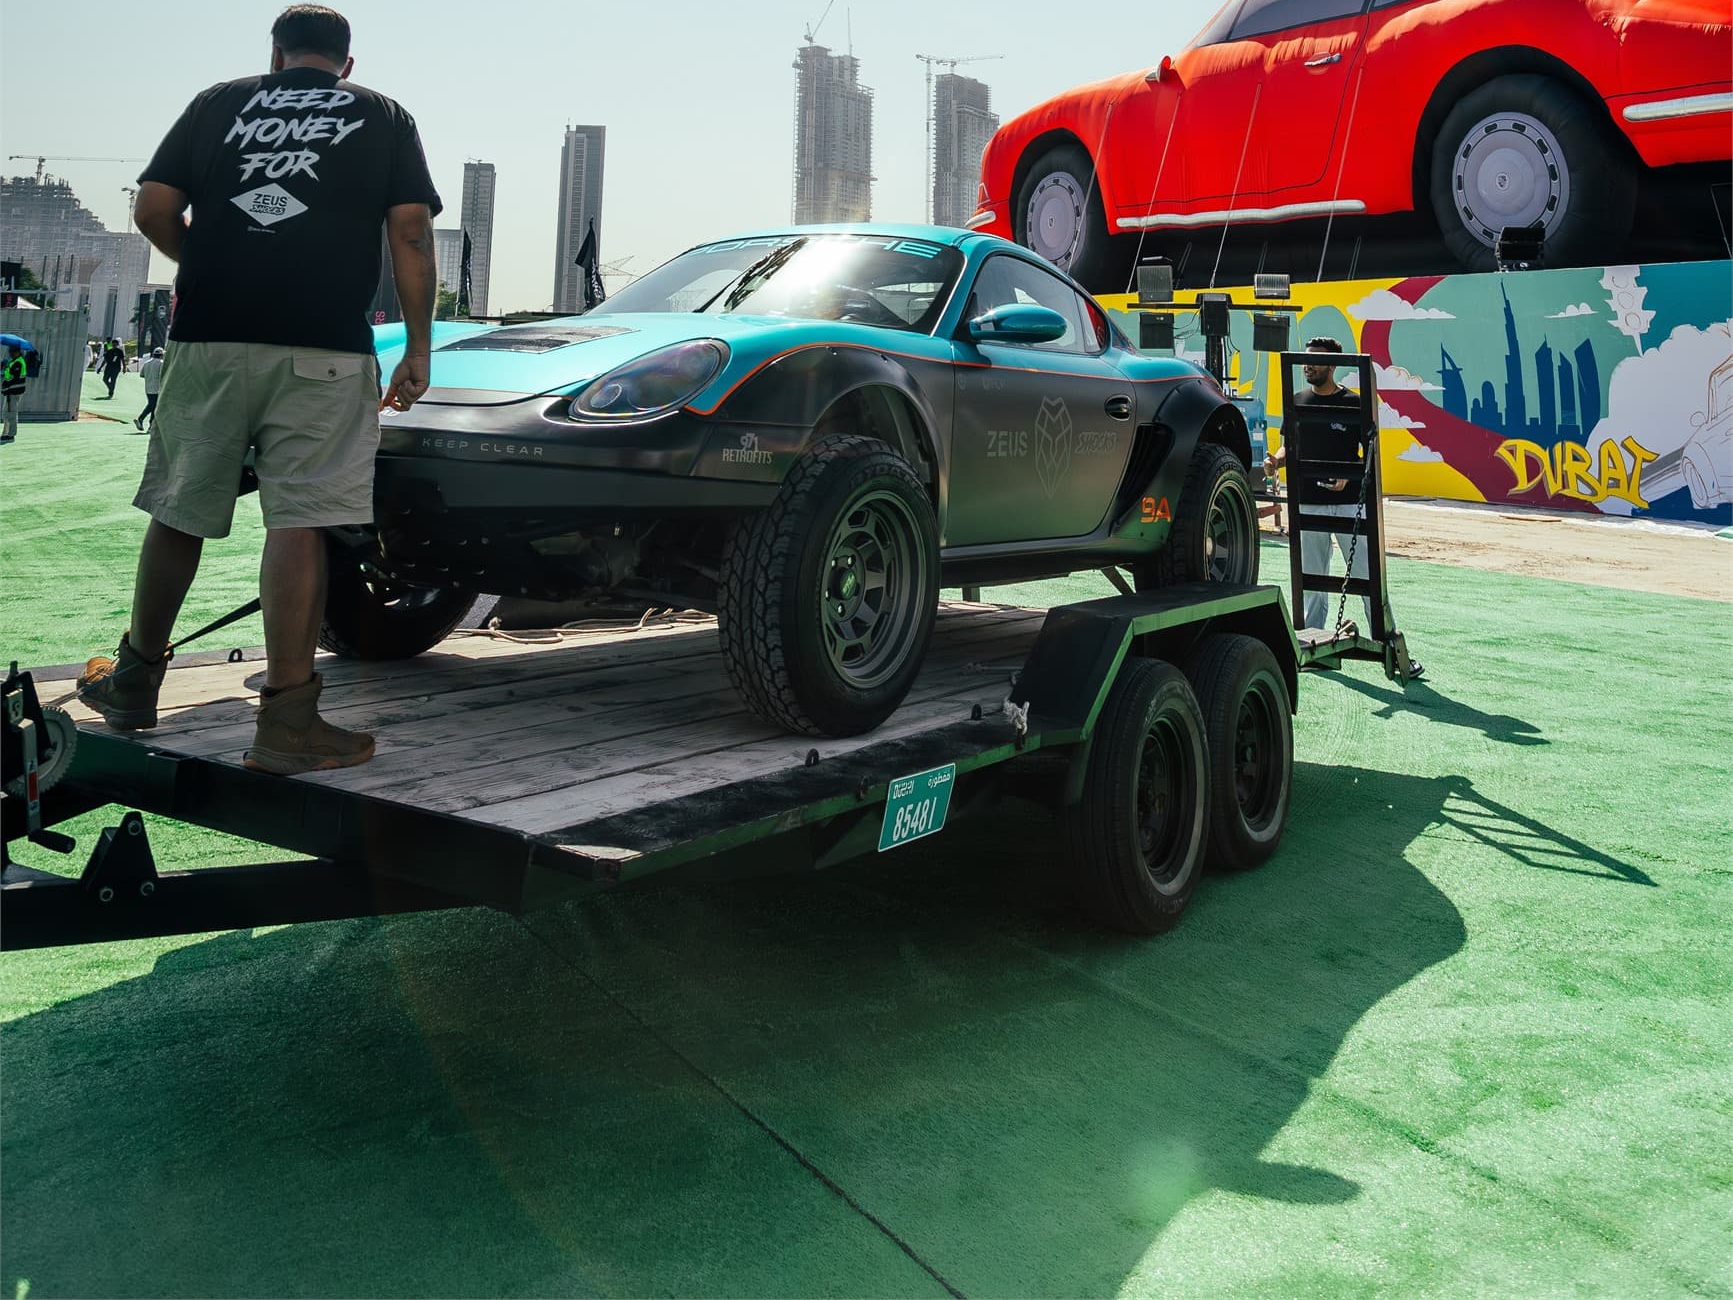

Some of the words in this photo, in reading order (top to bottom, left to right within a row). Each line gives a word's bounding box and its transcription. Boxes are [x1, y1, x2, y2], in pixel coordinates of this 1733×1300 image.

[240, 86, 356, 115] NEED
[224, 113, 366, 150] MONEY
[239, 147, 320, 183] FOR
[252, 193, 287, 207] ZEUS
[422, 438, 469, 449] KEEP
[480, 443, 543, 456] CLEAR
[740, 433, 758, 451] 971
[987, 431, 1028, 457] ZEUS
[722, 448, 773, 465] RETROFITS
[892, 796, 937, 841] 85481
